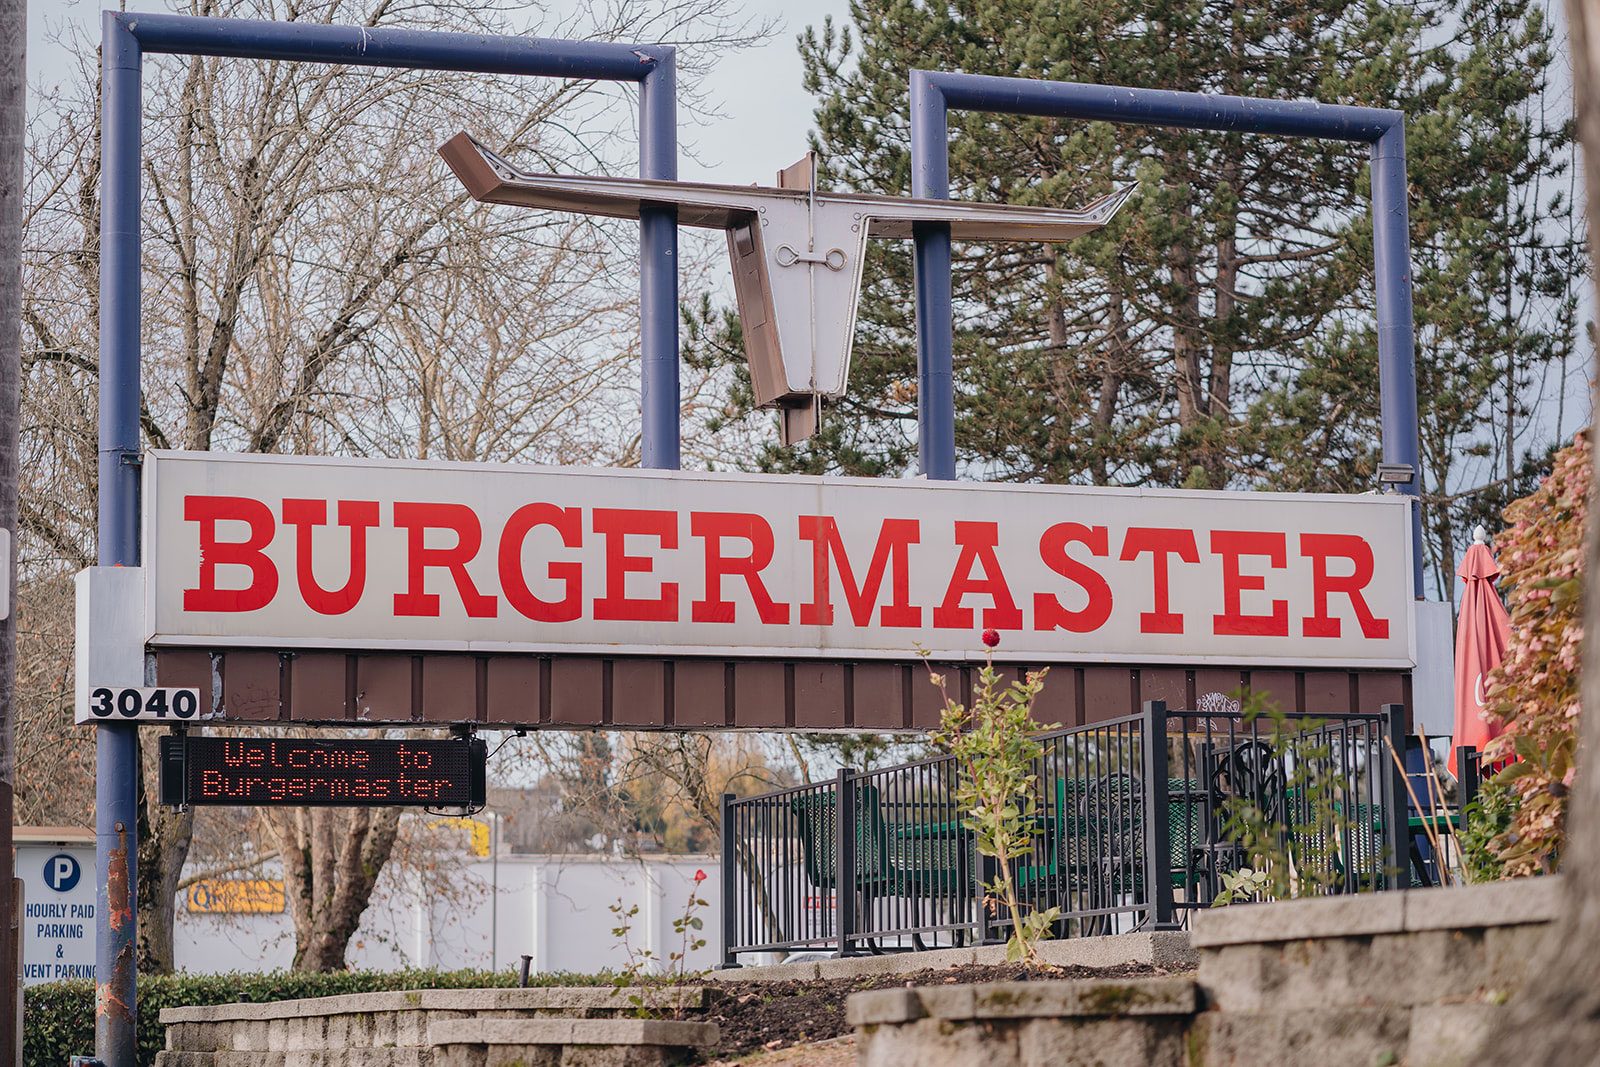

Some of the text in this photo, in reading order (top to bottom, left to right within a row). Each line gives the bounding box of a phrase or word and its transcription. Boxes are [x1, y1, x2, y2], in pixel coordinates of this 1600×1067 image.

[183, 495, 1390, 640] BURGERMASTER
[91, 688, 199, 719] 3040
[224, 742, 432, 769] Welcome to
[203, 770, 453, 800] Burgermaster
[54, 857, 73, 888] P
[26, 903, 94, 919] HOURLY PAID
[37, 923, 83, 938] PARKING
[55, 943, 64, 959] &
[24, 963, 52, 979] VENT
